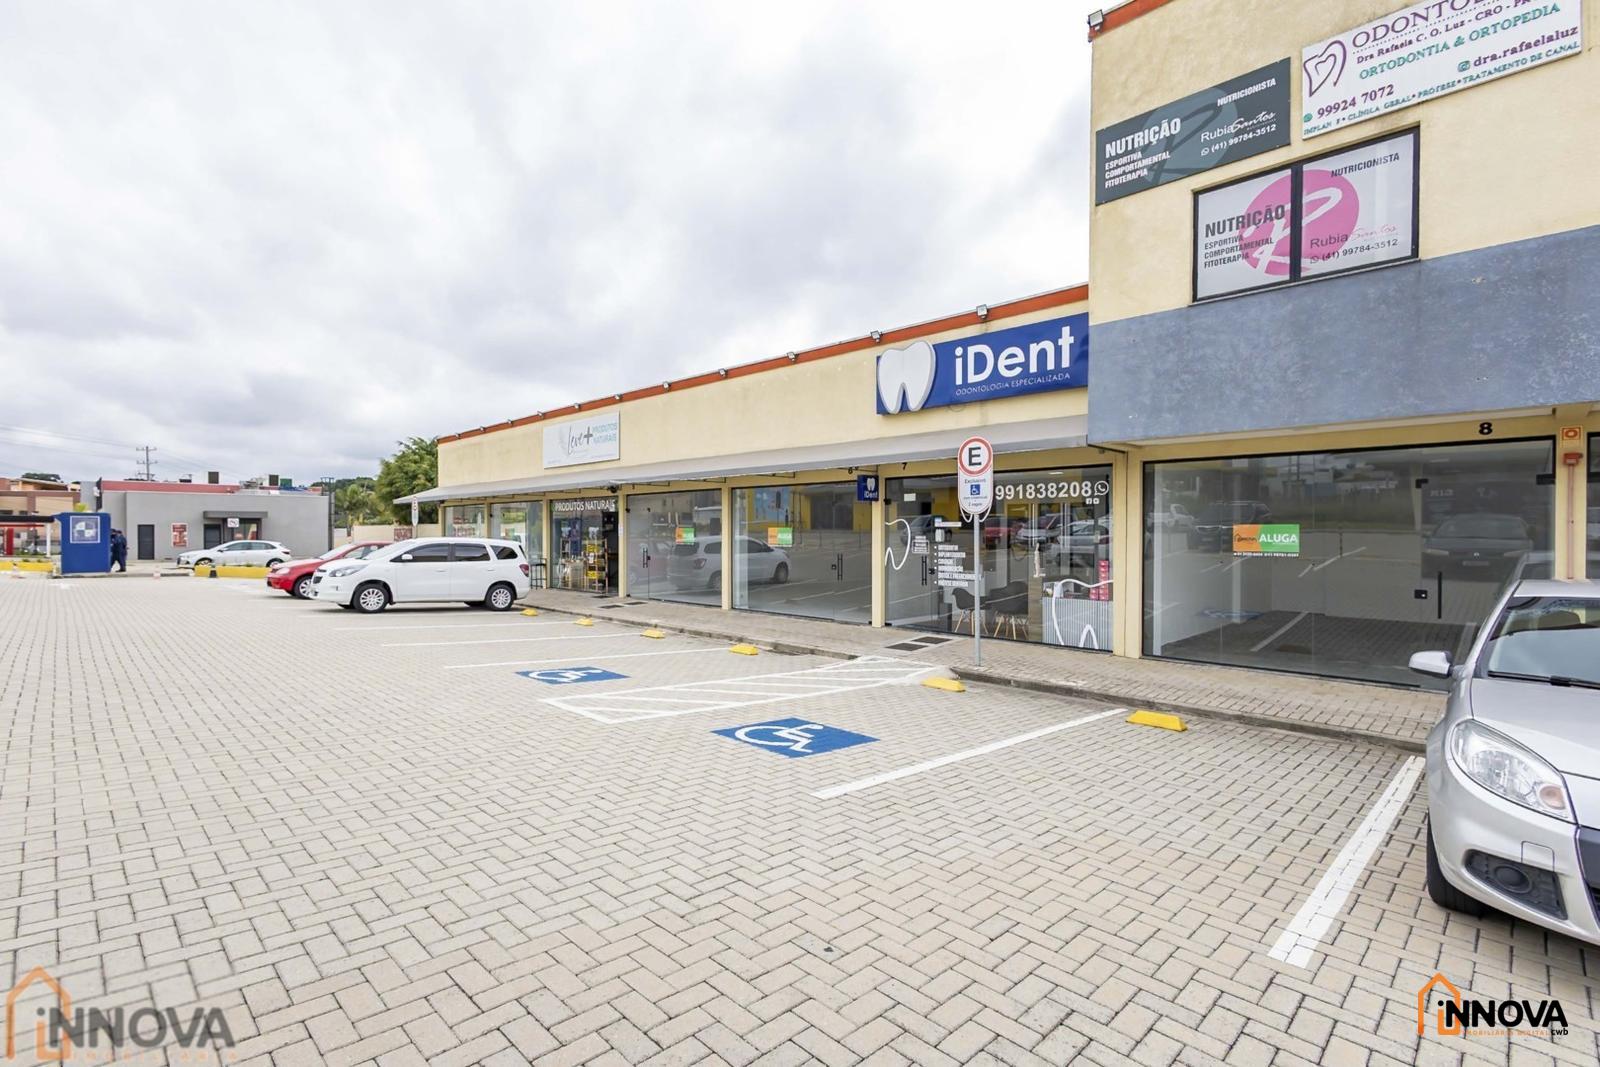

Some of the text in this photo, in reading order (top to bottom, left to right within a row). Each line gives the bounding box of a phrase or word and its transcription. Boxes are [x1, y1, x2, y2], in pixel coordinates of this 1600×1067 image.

[1356, 53, 1375, 65] Dra
[1377, 39, 1414, 57] Rafaela
[1416, 33, 1428, 44] C.
[1430, 28, 1442, 38] O.
[1445, 19, 1466, 33] Luz
[1474, 5, 1503, 22] CRO
[1359, 3, 1561, 80] ORTODONTIA & ORTOPEDIA
[1473, 26, 1579, 68] dra.rafaelaluz
[1383, 95, 1412, 109] GERAL
[1462, 58, 1528, 84] TRATAMENTO
[1530, 52, 1543, 63] DE
[1545, 41, 1580, 58] CANAL
[1216, 78, 1277, 107] NUTRICIONISTA
[1316, 84, 1395, 119] 99924 7072
[1104, 116, 1182, 159] NUTRIÇÃO
[1200, 124, 1233, 143] Rubia
[1230, 111, 1277, 133] Santos
[1211, 140, 1228, 153] (41)
[1228, 124, 1277, 147] 99784-3512
[1104, 151, 1143, 171] ESPORTIVA
[1104, 150, 1172, 180] COMPORTAMENTAL
[1330, 152, 1400, 178] NUTRICIONISTA
[1104, 169, 1149, 189] FITOTERAPIA
[1204, 203, 1286, 239] NUTRIÇÃO
[1204, 233, 1245, 250] ESPORTIVA
[1204, 236, 1274, 260] COMPORTAMENTAL
[1309, 228, 1349, 249] Rubia
[1321, 238, 1399, 262] (41) 99784-3512
[1204, 252, 1250, 269] FITOTERAPIA
[954, 325, 1075, 386] iDent
[955, 372, 1071, 397] ODONTOLOGIA ESPECIALIZADA
[1478, 421, 1493, 436] 8
[901, 461, 908, 471] 7
[968, 446, 982, 466] E
[994, 480, 1093, 500] 991838208
[555, 501, 585, 512] PRODUTOS
[1259, 533, 1298, 543] ALUGA
